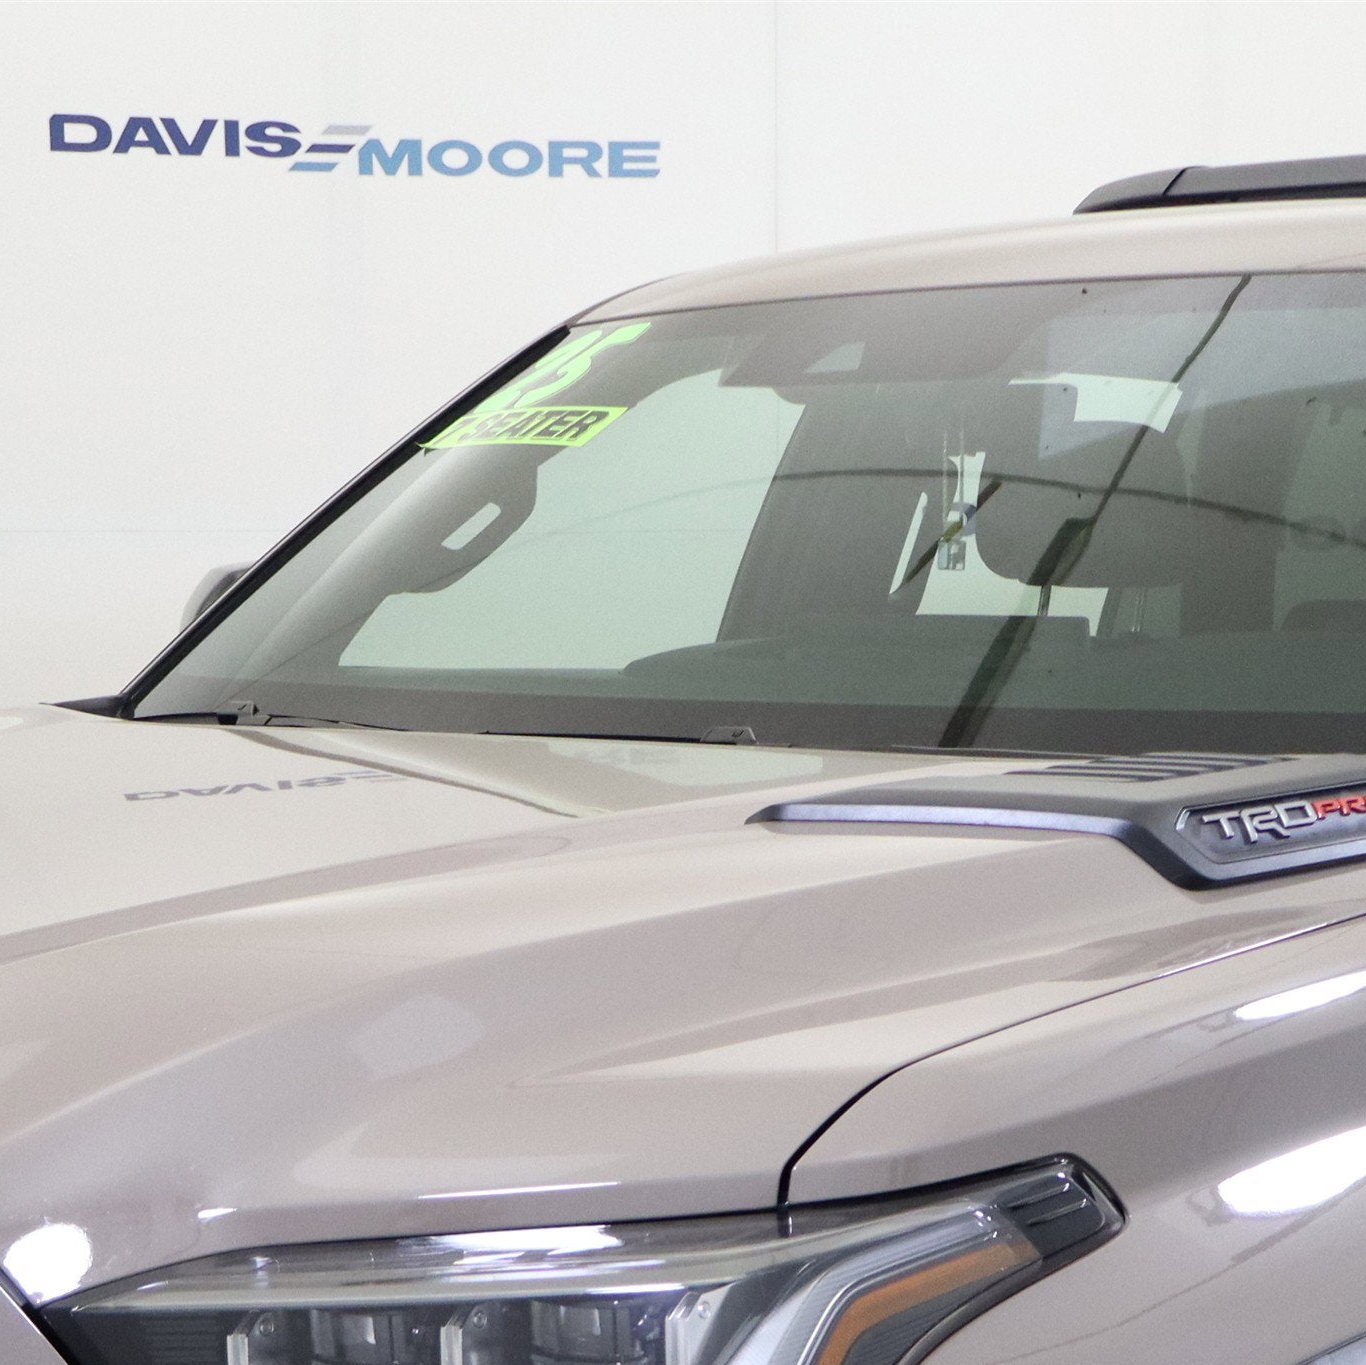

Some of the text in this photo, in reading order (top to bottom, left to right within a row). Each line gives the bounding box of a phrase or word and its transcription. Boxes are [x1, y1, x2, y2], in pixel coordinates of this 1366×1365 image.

[48, 113, 661, 179] DAVIS MOORE
[457, 409, 611, 442] SEATER
[1201, 801, 1319, 844] TRD
